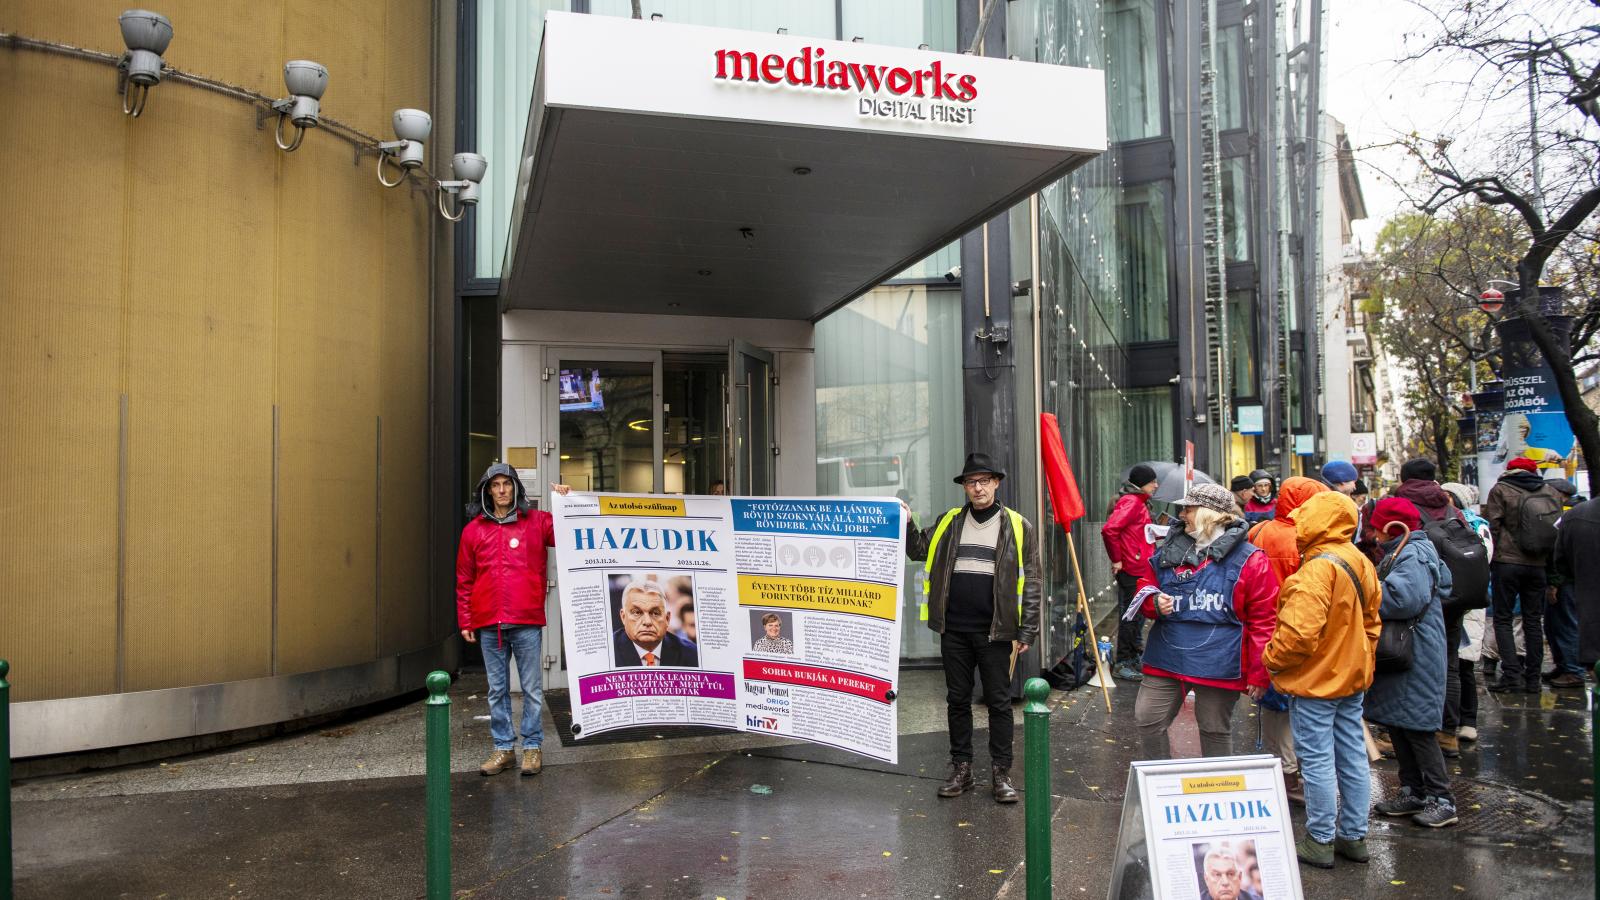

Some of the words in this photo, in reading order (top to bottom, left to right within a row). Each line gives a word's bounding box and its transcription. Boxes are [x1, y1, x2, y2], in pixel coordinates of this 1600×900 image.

[714, 46, 978, 101] mediaworks
[859, 97, 927, 121] DIGITAL
[930, 104, 977, 125] FIRST
[608, 501, 617, 509] Az
[820, 504, 832, 512] BE
[843, 504, 882, 515] LÁNYOK
[743, 510, 774, 520] RÖVID
[776, 512, 830, 522] SZOKNYÁJA
[857, 514, 889, 524] MINÉL
[810, 522, 842, 532] ANNÁL
[573, 528, 719, 552] HAZUDIK
[752, 581, 788, 592] ÉVENTE
[790, 584, 816, 594] TÖBB
[818, 586, 834, 595] TÍZ
[836, 588, 882, 600] MILLIÁRD
[761, 592, 815, 602] FORINTBÓL
[818, 596, 872, 608] HAZUDNAK?
[605, 674, 626, 684] NEM
[628, 672, 666, 680] TUDTÁK
[668, 674, 700, 682] LEADNI
[762, 667, 792, 678] SORRA
[794, 670, 828, 682] BUKJÁK
[838, 677, 876, 692] PEREKET
[617, 688, 648, 696] SOKAT
[651, 687, 700, 696] HAZUDTAK
[707, 682, 724, 690] TÚL
[744, 682, 766, 696] Magyar
[768, 685, 789, 698] Nemzet
[746, 704, 790, 714] mediaworks
[766, 698, 790, 706] ORIGO
[1165, 800, 1272, 824] HAZUDIK
